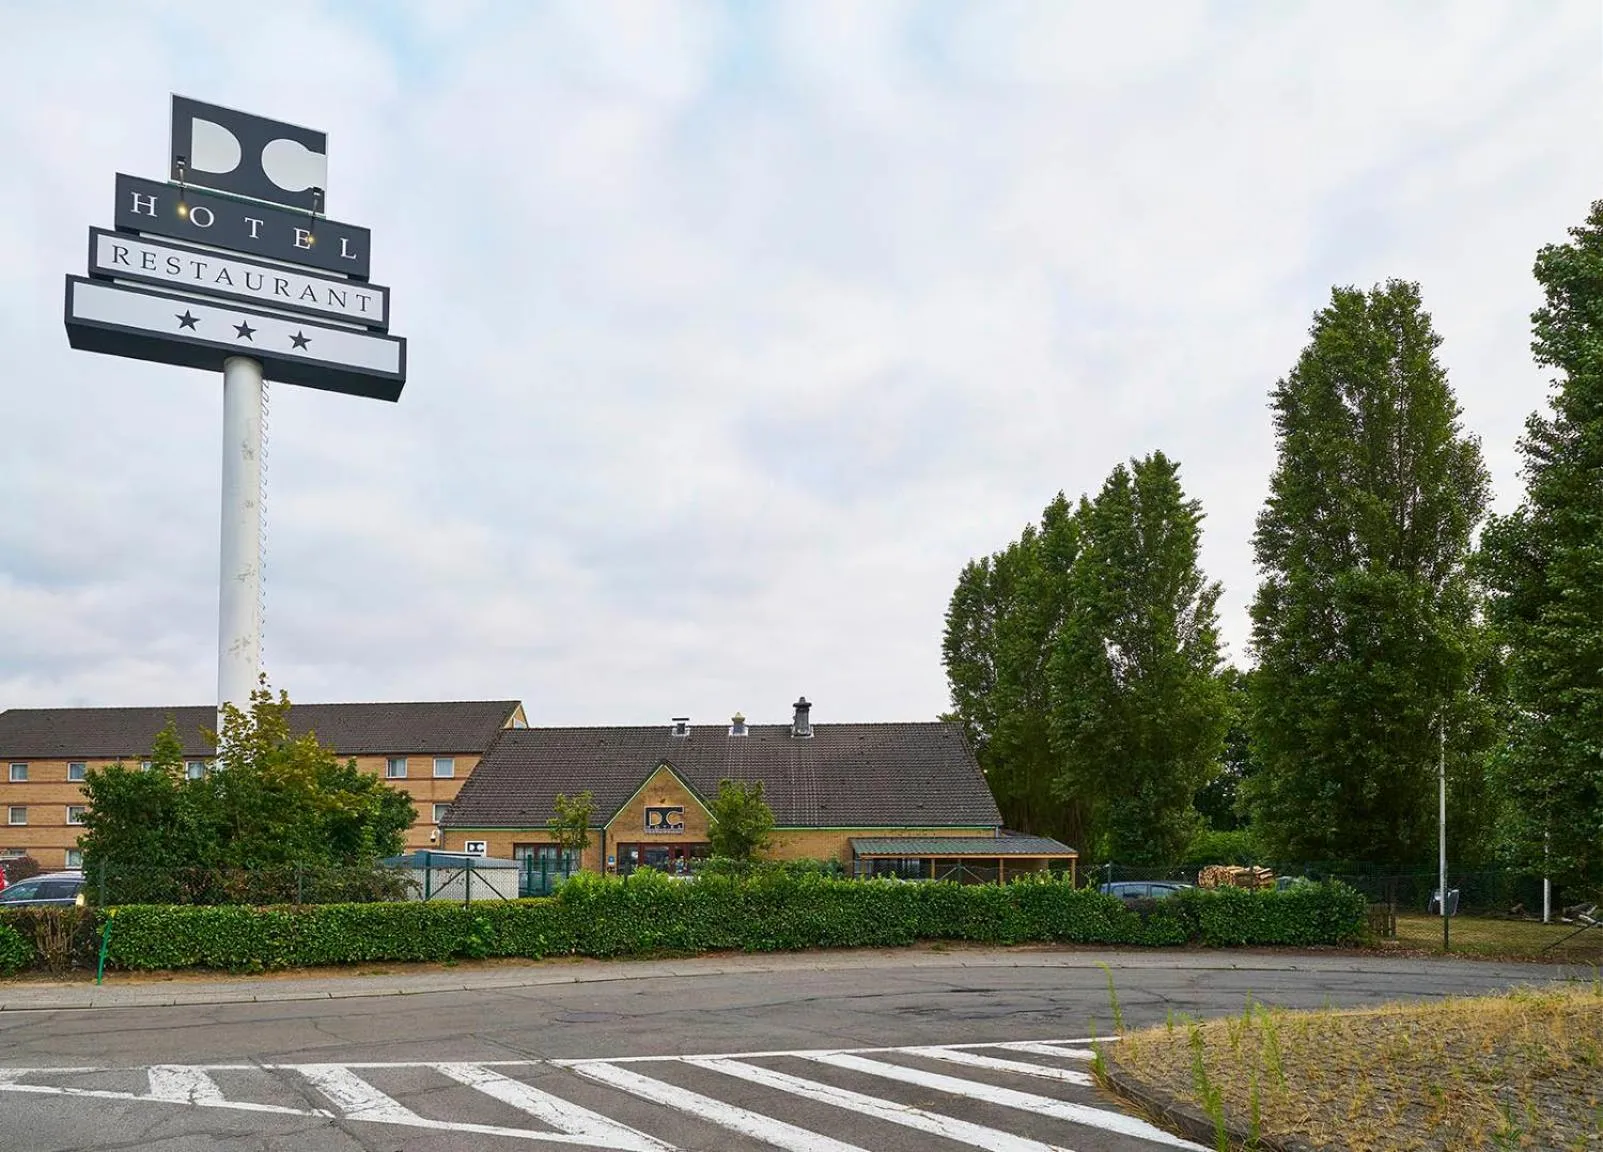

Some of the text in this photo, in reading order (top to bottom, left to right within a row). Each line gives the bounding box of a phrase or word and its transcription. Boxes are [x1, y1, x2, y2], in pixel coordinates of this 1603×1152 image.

[191, 117, 327, 193] DC
[130, 192, 357, 261] HOTEL
[112, 245, 372, 313] RESTAURANT
[649, 811, 684, 826] DC
